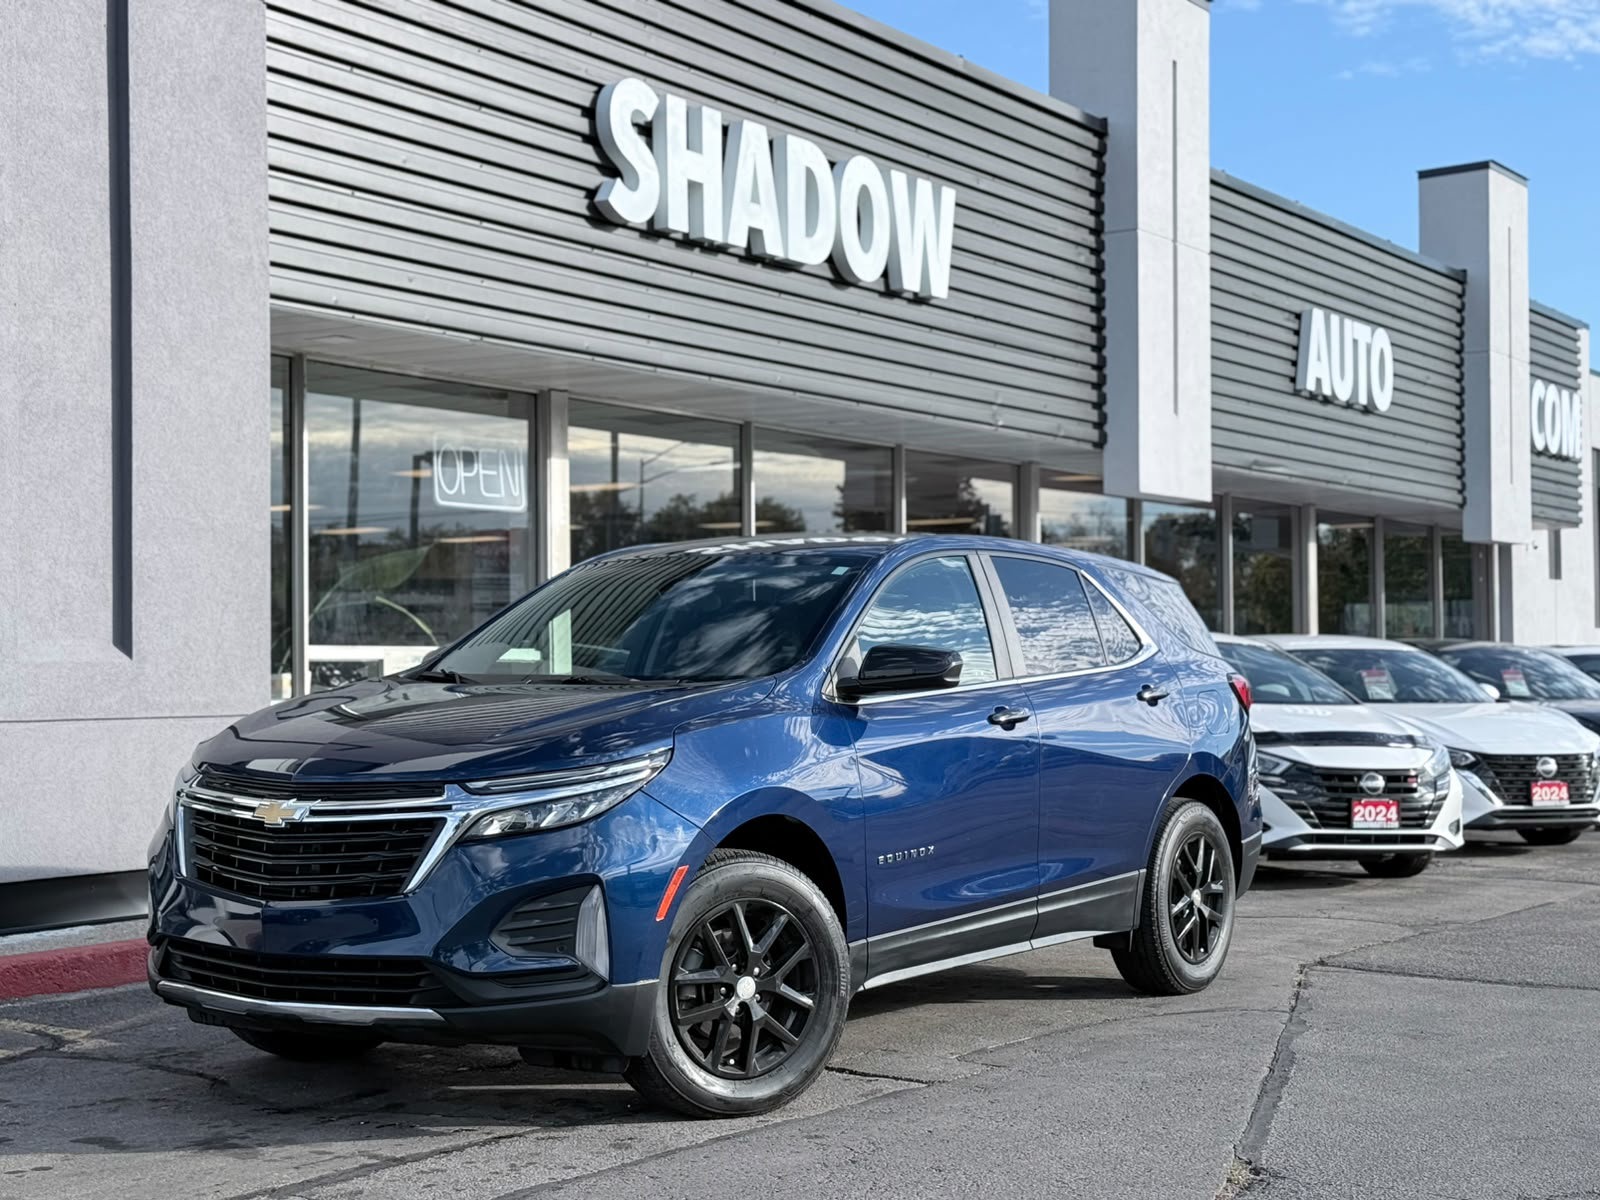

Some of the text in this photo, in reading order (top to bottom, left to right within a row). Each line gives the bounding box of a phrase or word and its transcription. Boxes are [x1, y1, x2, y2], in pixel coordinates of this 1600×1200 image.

[595, 77, 956, 299] SHADOW
[1299, 307, 1393, 412] AUTO
[1531, 379, 1582, 459] COM
[437, 443, 519, 497] OPEN
[1353, 805, 1398, 821] 2024
[1531, 786, 1569, 800] 2024
[877, 845, 934, 865] EQUINOX
